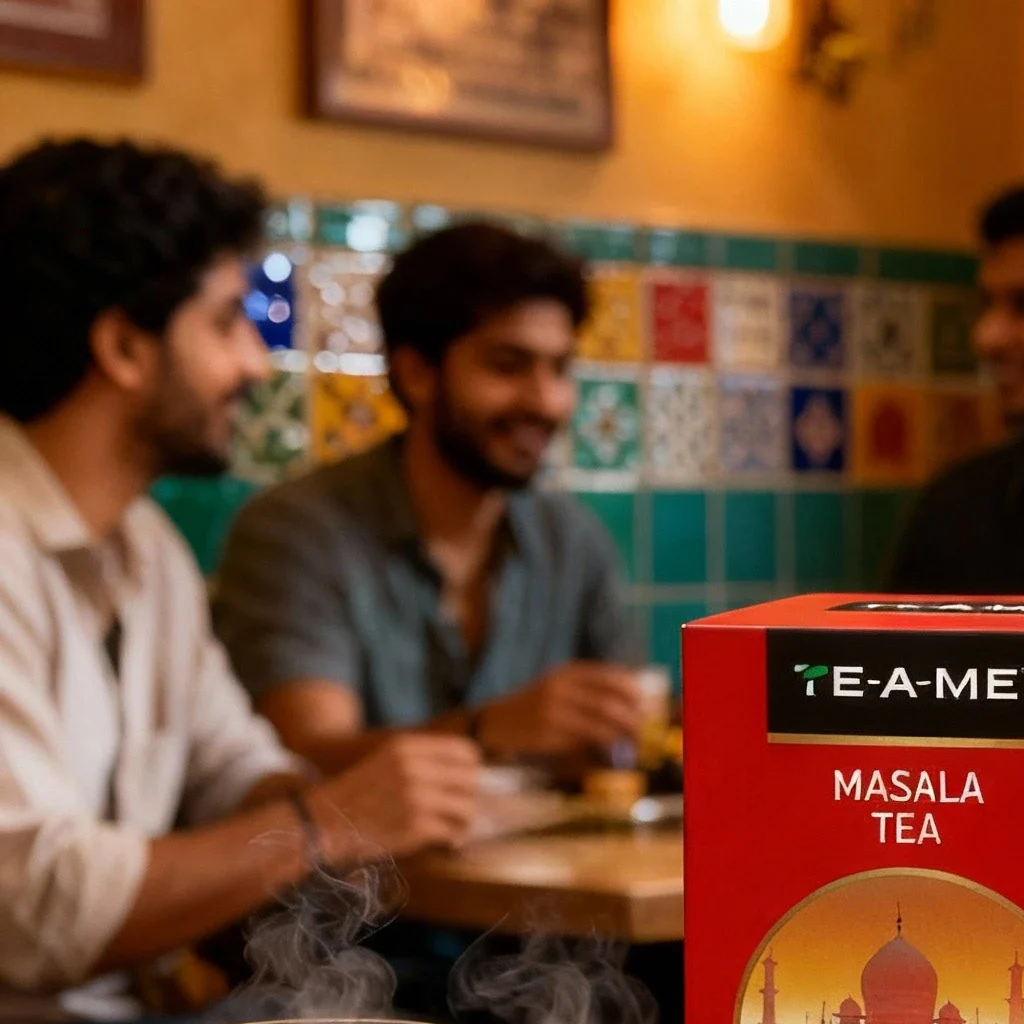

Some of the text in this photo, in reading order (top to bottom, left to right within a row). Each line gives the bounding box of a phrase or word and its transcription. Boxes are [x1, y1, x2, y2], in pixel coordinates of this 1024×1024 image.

[794, 664, 1019, 700] TE-A-ME
[834, 769, 985, 804] MASALA
[871, 812, 942, 845] TEA
